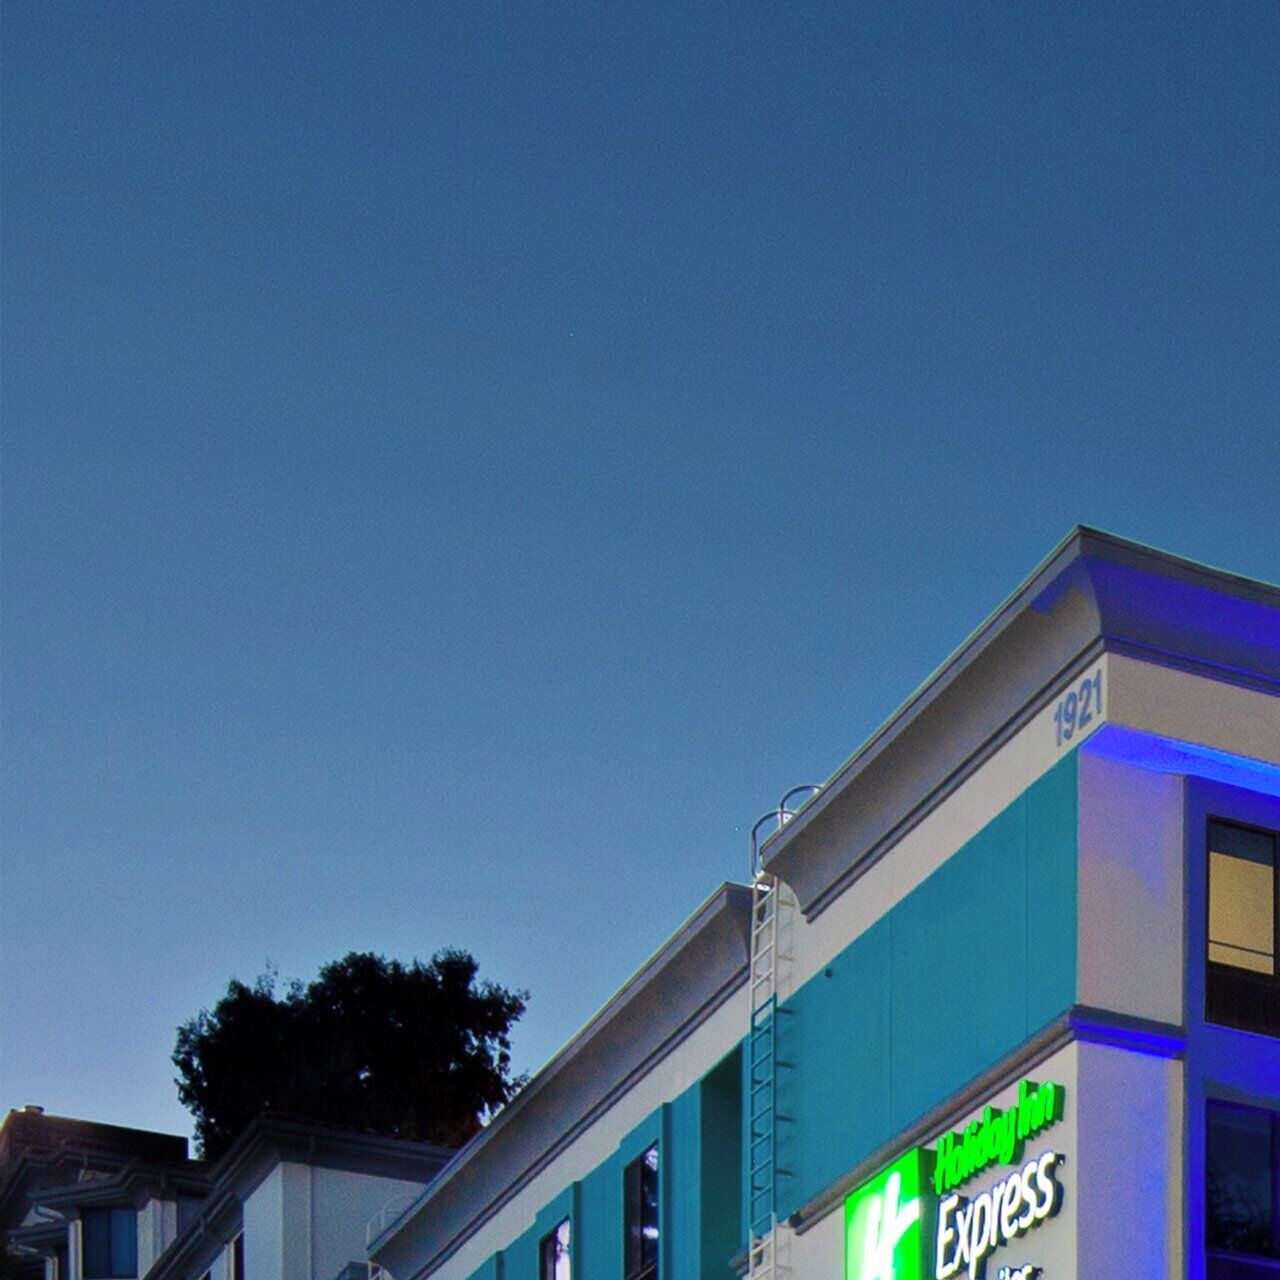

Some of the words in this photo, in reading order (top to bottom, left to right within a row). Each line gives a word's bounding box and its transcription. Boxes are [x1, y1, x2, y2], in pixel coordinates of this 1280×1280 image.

[1054, 669, 1102, 746] 1921
[934, 1108, 1015, 1194] Holiday
[1016, 1080, 1054, 1138] Inn
[935, 1151, 1056, 1280] Express
